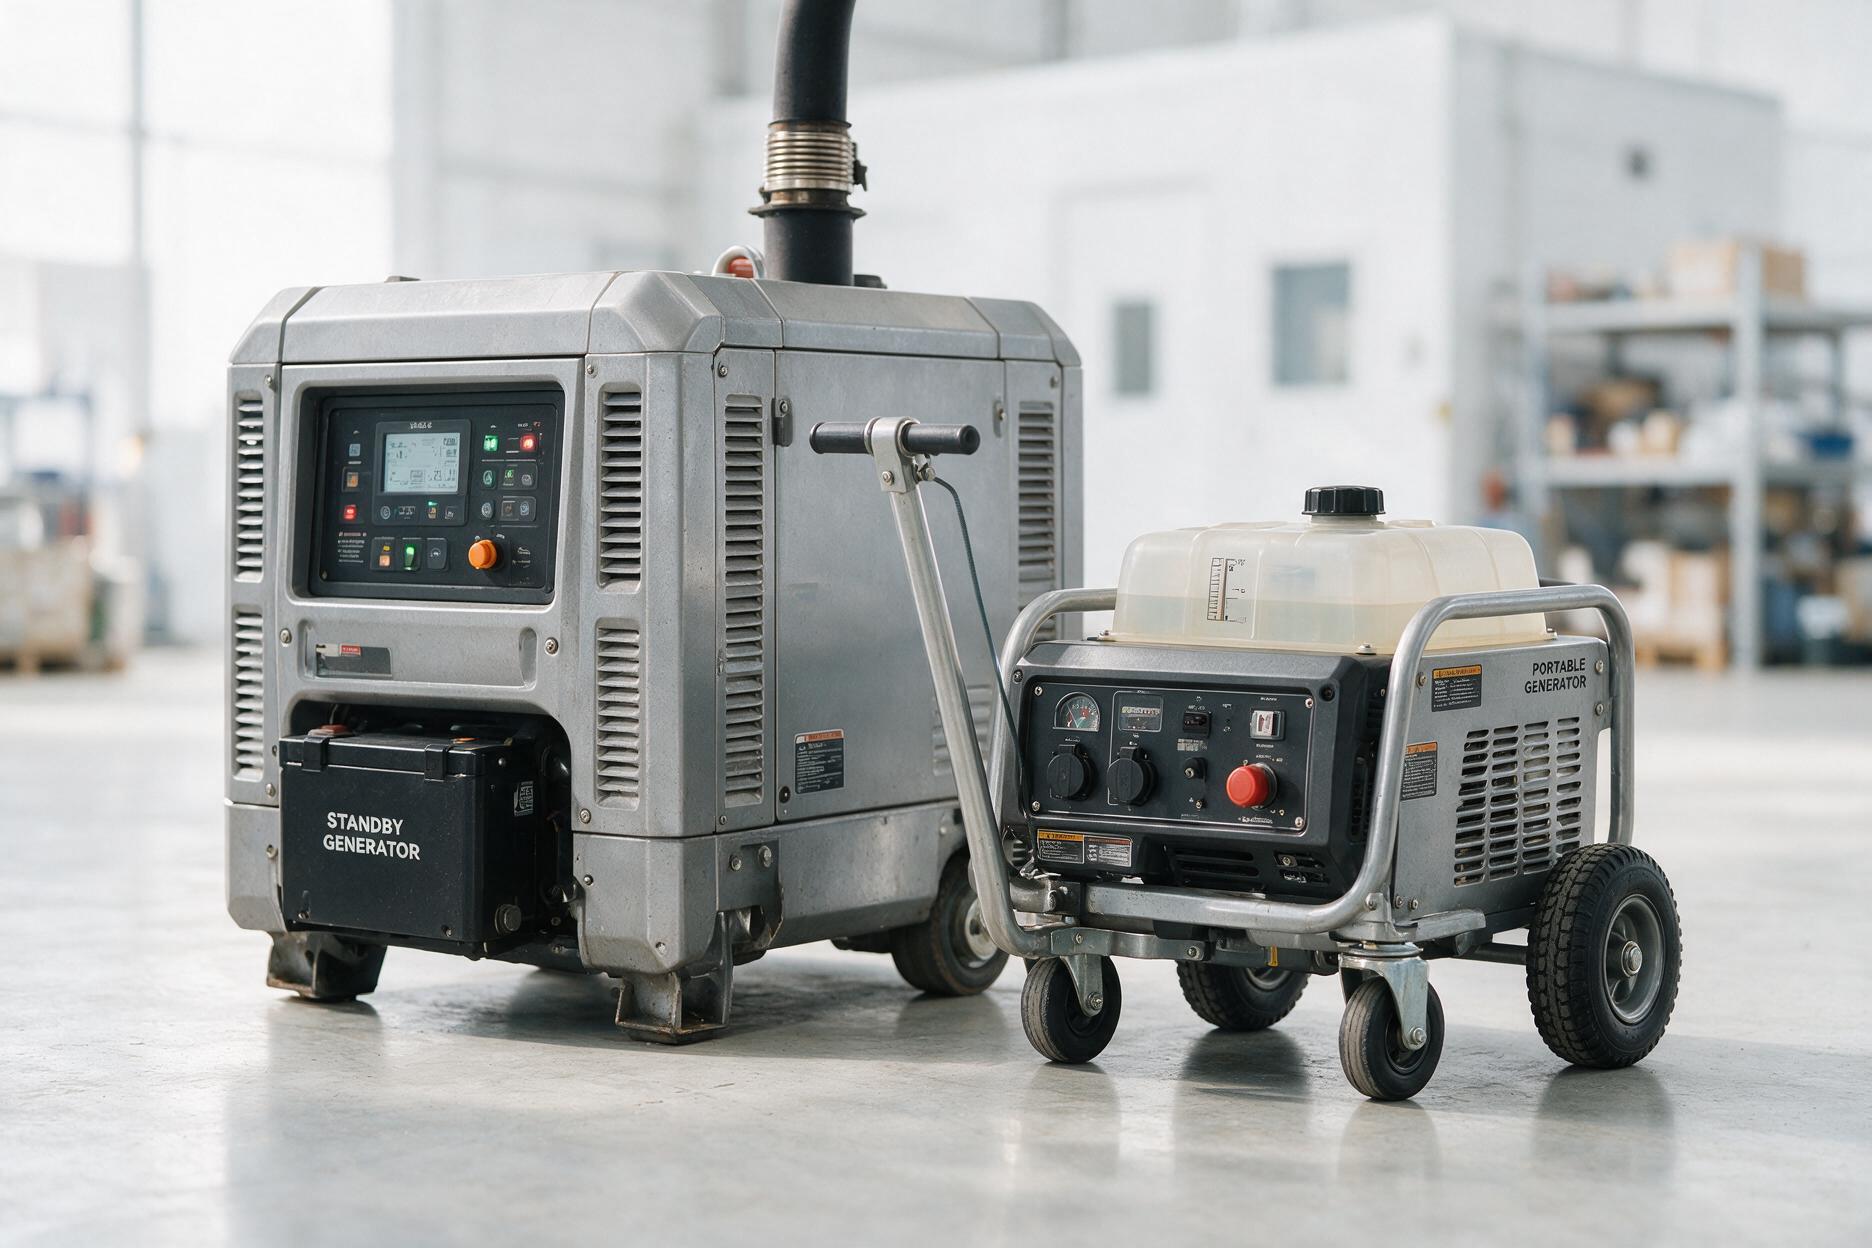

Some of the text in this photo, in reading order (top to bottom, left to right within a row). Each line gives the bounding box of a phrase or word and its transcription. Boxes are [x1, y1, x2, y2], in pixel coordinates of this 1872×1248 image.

[1532, 657, 1586, 676] PORTABLE
[1524, 675, 1587, 694] GENERATOR
[327, 811, 403, 835] STANDBY
[322, 834, 420, 861] GENERATOR
